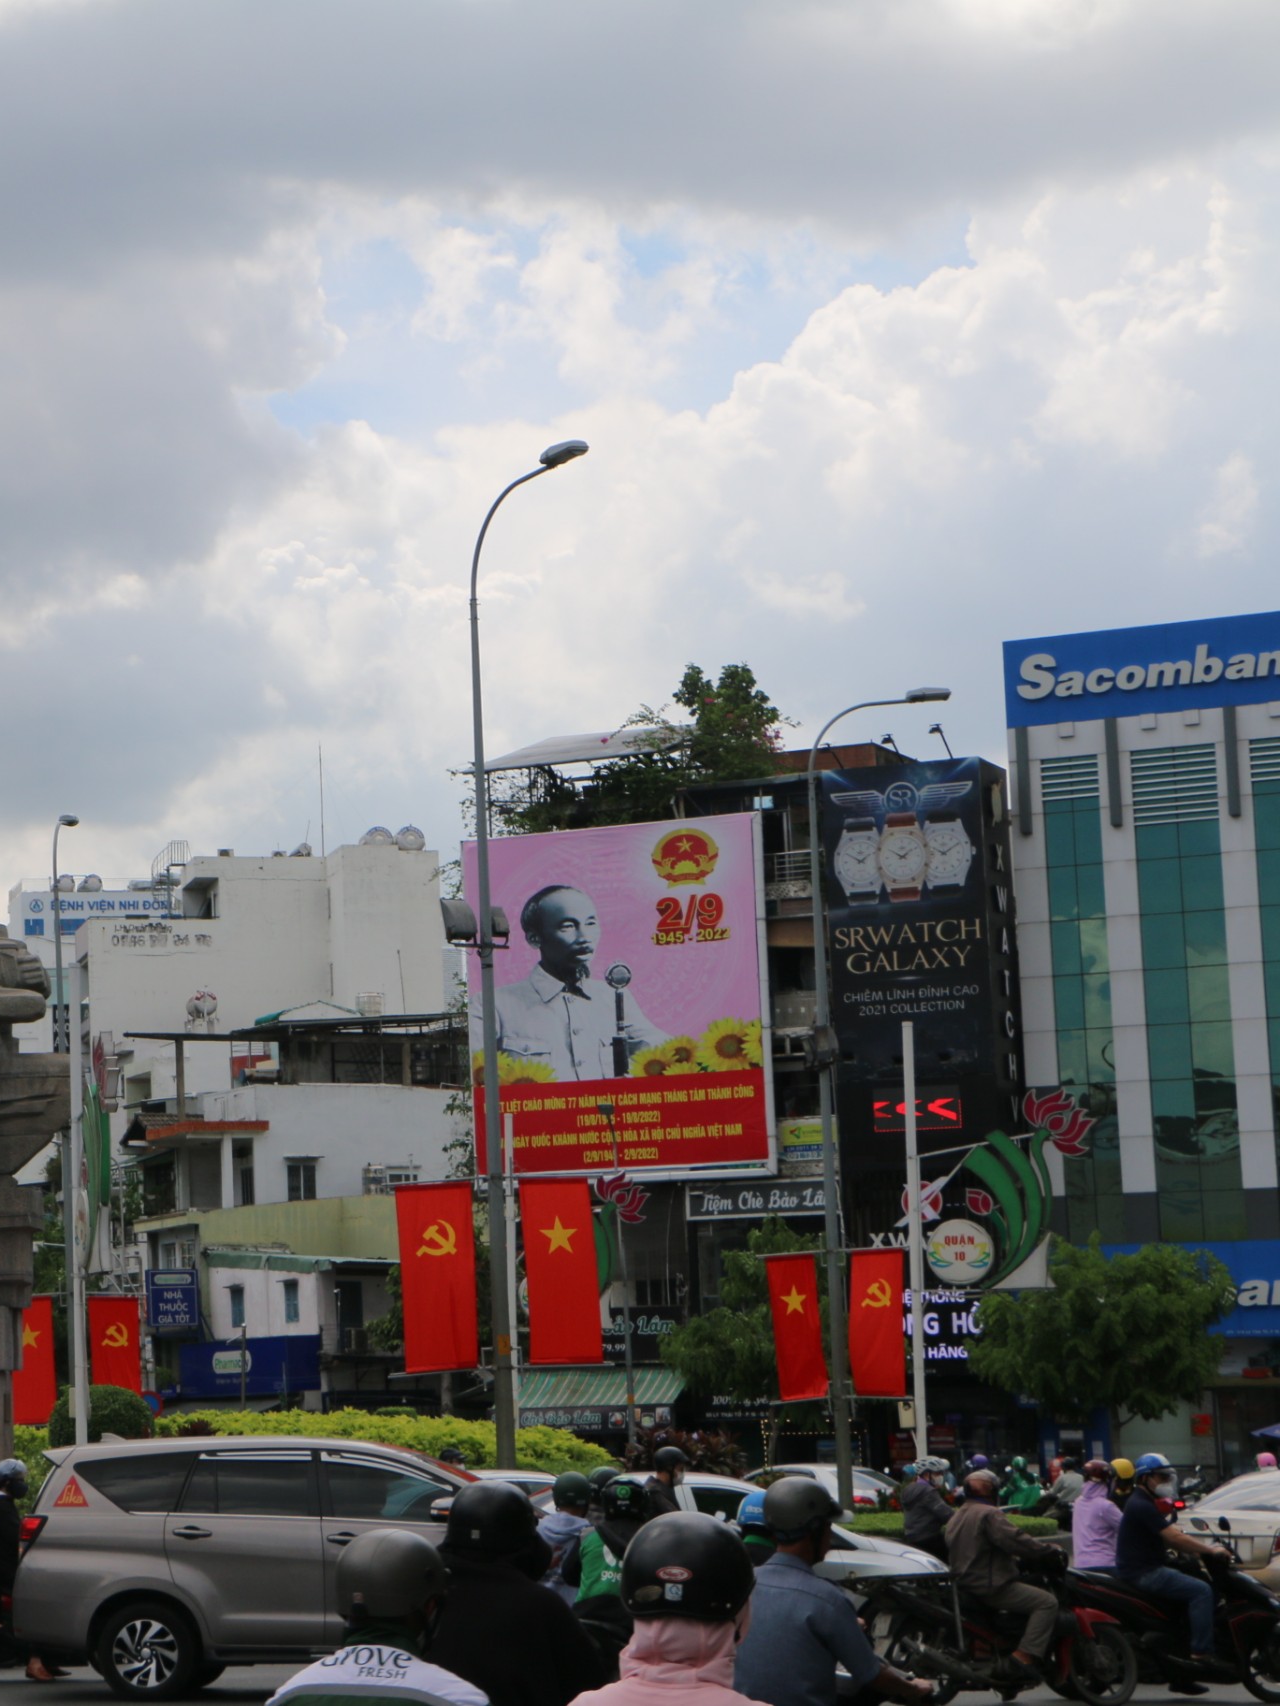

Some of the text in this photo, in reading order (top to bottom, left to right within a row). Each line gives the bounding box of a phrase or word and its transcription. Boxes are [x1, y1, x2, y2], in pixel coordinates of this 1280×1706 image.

[88, 898, 116, 913] VIỆN
[120, 900, 139, 911] NHI
[656, 893, 724, 932] 2/9
[652, 931, 684, 945] 1945
[697, 927, 730, 942] 2022
[835, 918, 983, 952] SRWATCH
[846, 946, 971, 974] GALAXY
[953, 985, 979, 996] CAO
[859, 1001, 965, 1016] 2021 COLLECTION
[523, 1096, 542, 1112] CHÀO
[568, 1097, 577, 1109] 77
[579, 1094, 596, 1108] NĂM
[618, 1092, 637, 1106] CÁCH
[640, 1091, 662, 1107] MẠNG
[664, 1088, 688, 1103] THÁNG
[689, 1087, 706, 1101] TÁM
[708, 1086, 732, 1101] THÀNH
[733, 1084, 754, 1098] CÔNG
[577, 1114, 615, 1127] (19/8/195
[531, 1131, 551, 1148] QUỐC
[552, 1131, 577, 1146] KHÁNH
[640, 1126, 650, 1140] XÃ
[652, 1126, 664, 1142] HỘI
[666, 1124, 680, 1139] CHỦ
[683, 1124, 705, 1139] NGHĨA
[707, 1123, 723, 1139] VIỆT
[725, 1124, 742, 1136] NAM
[701, 1187, 826, 1215] Tiệm Chè Bảo Lâ
[954, 1252, 965, 1261] 10
[58, 1485, 83, 1504] Sika
[357, 1666, 407, 1680] FRESH
